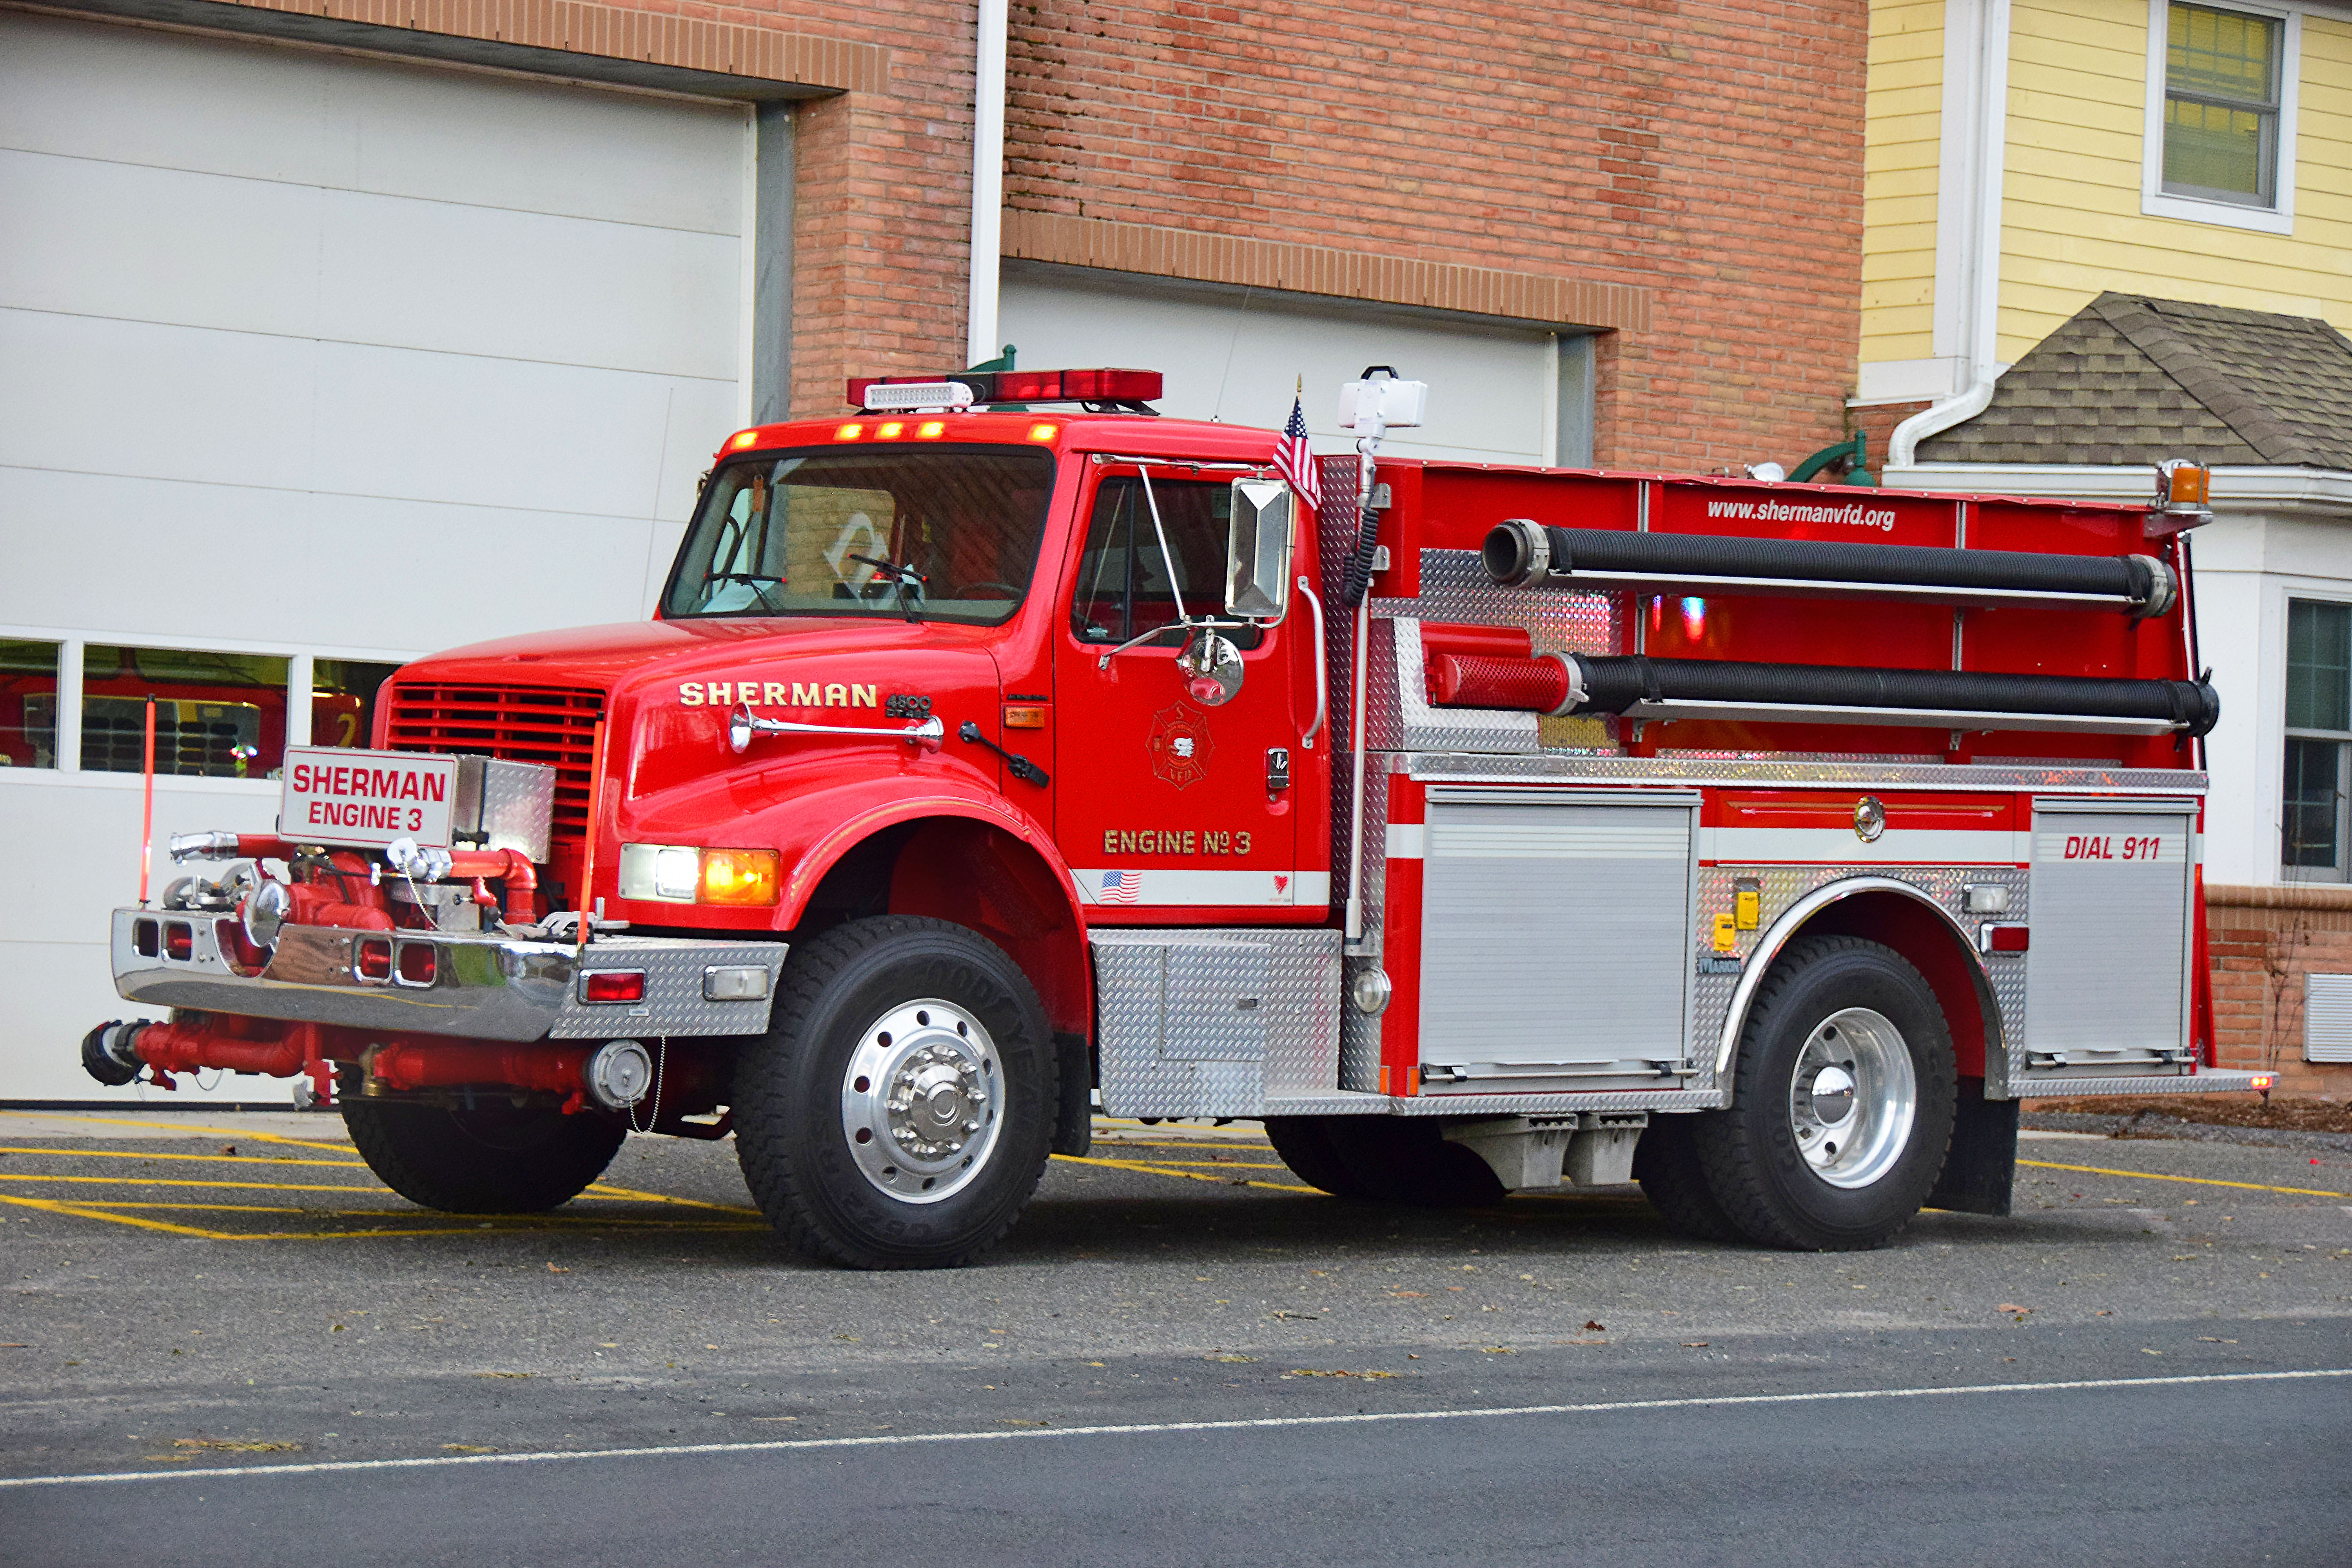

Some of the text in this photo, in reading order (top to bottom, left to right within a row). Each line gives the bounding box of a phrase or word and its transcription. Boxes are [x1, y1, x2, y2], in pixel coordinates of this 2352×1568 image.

[1708, 499, 1896, 532] www.shermanvfd.org
[679, 682, 877, 707] SHERMAN
[338, 713, 356, 747] 2
[293, 764, 445, 802] SHERMAN
[309, 801, 422, 831] ENGINE 3
[1104, 829, 1195, 854] ENGINE
[1235, 831, 1251, 855] 3
[2064, 836, 2160, 860] DIAL 911
